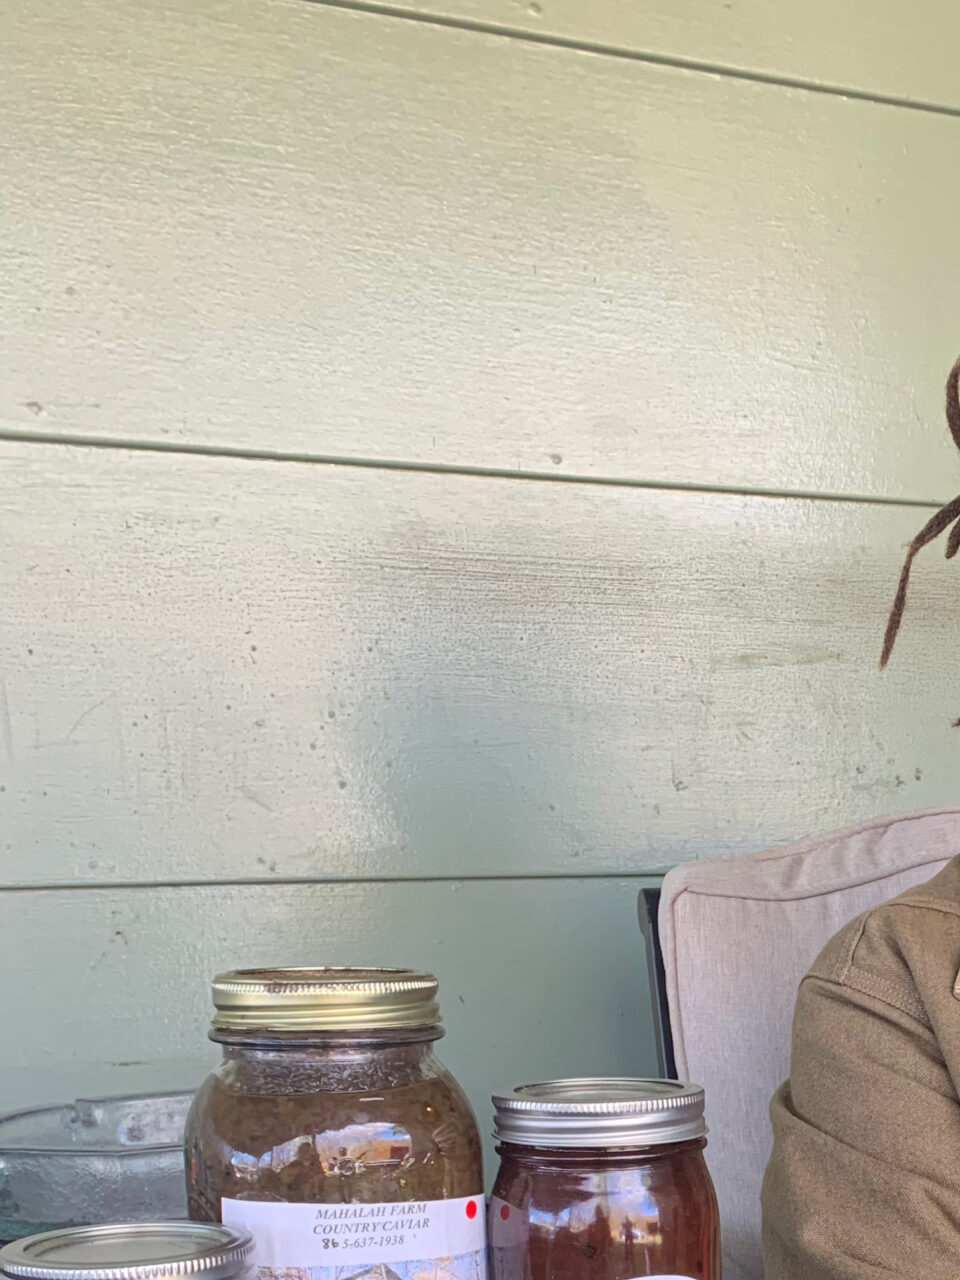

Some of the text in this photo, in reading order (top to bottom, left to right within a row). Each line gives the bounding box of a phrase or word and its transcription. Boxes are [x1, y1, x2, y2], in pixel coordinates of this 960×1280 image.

[315, 1203, 427, 1220] MAHALAH FARM
[313, 1217, 430, 1235] COUNTRY CAVIAR
